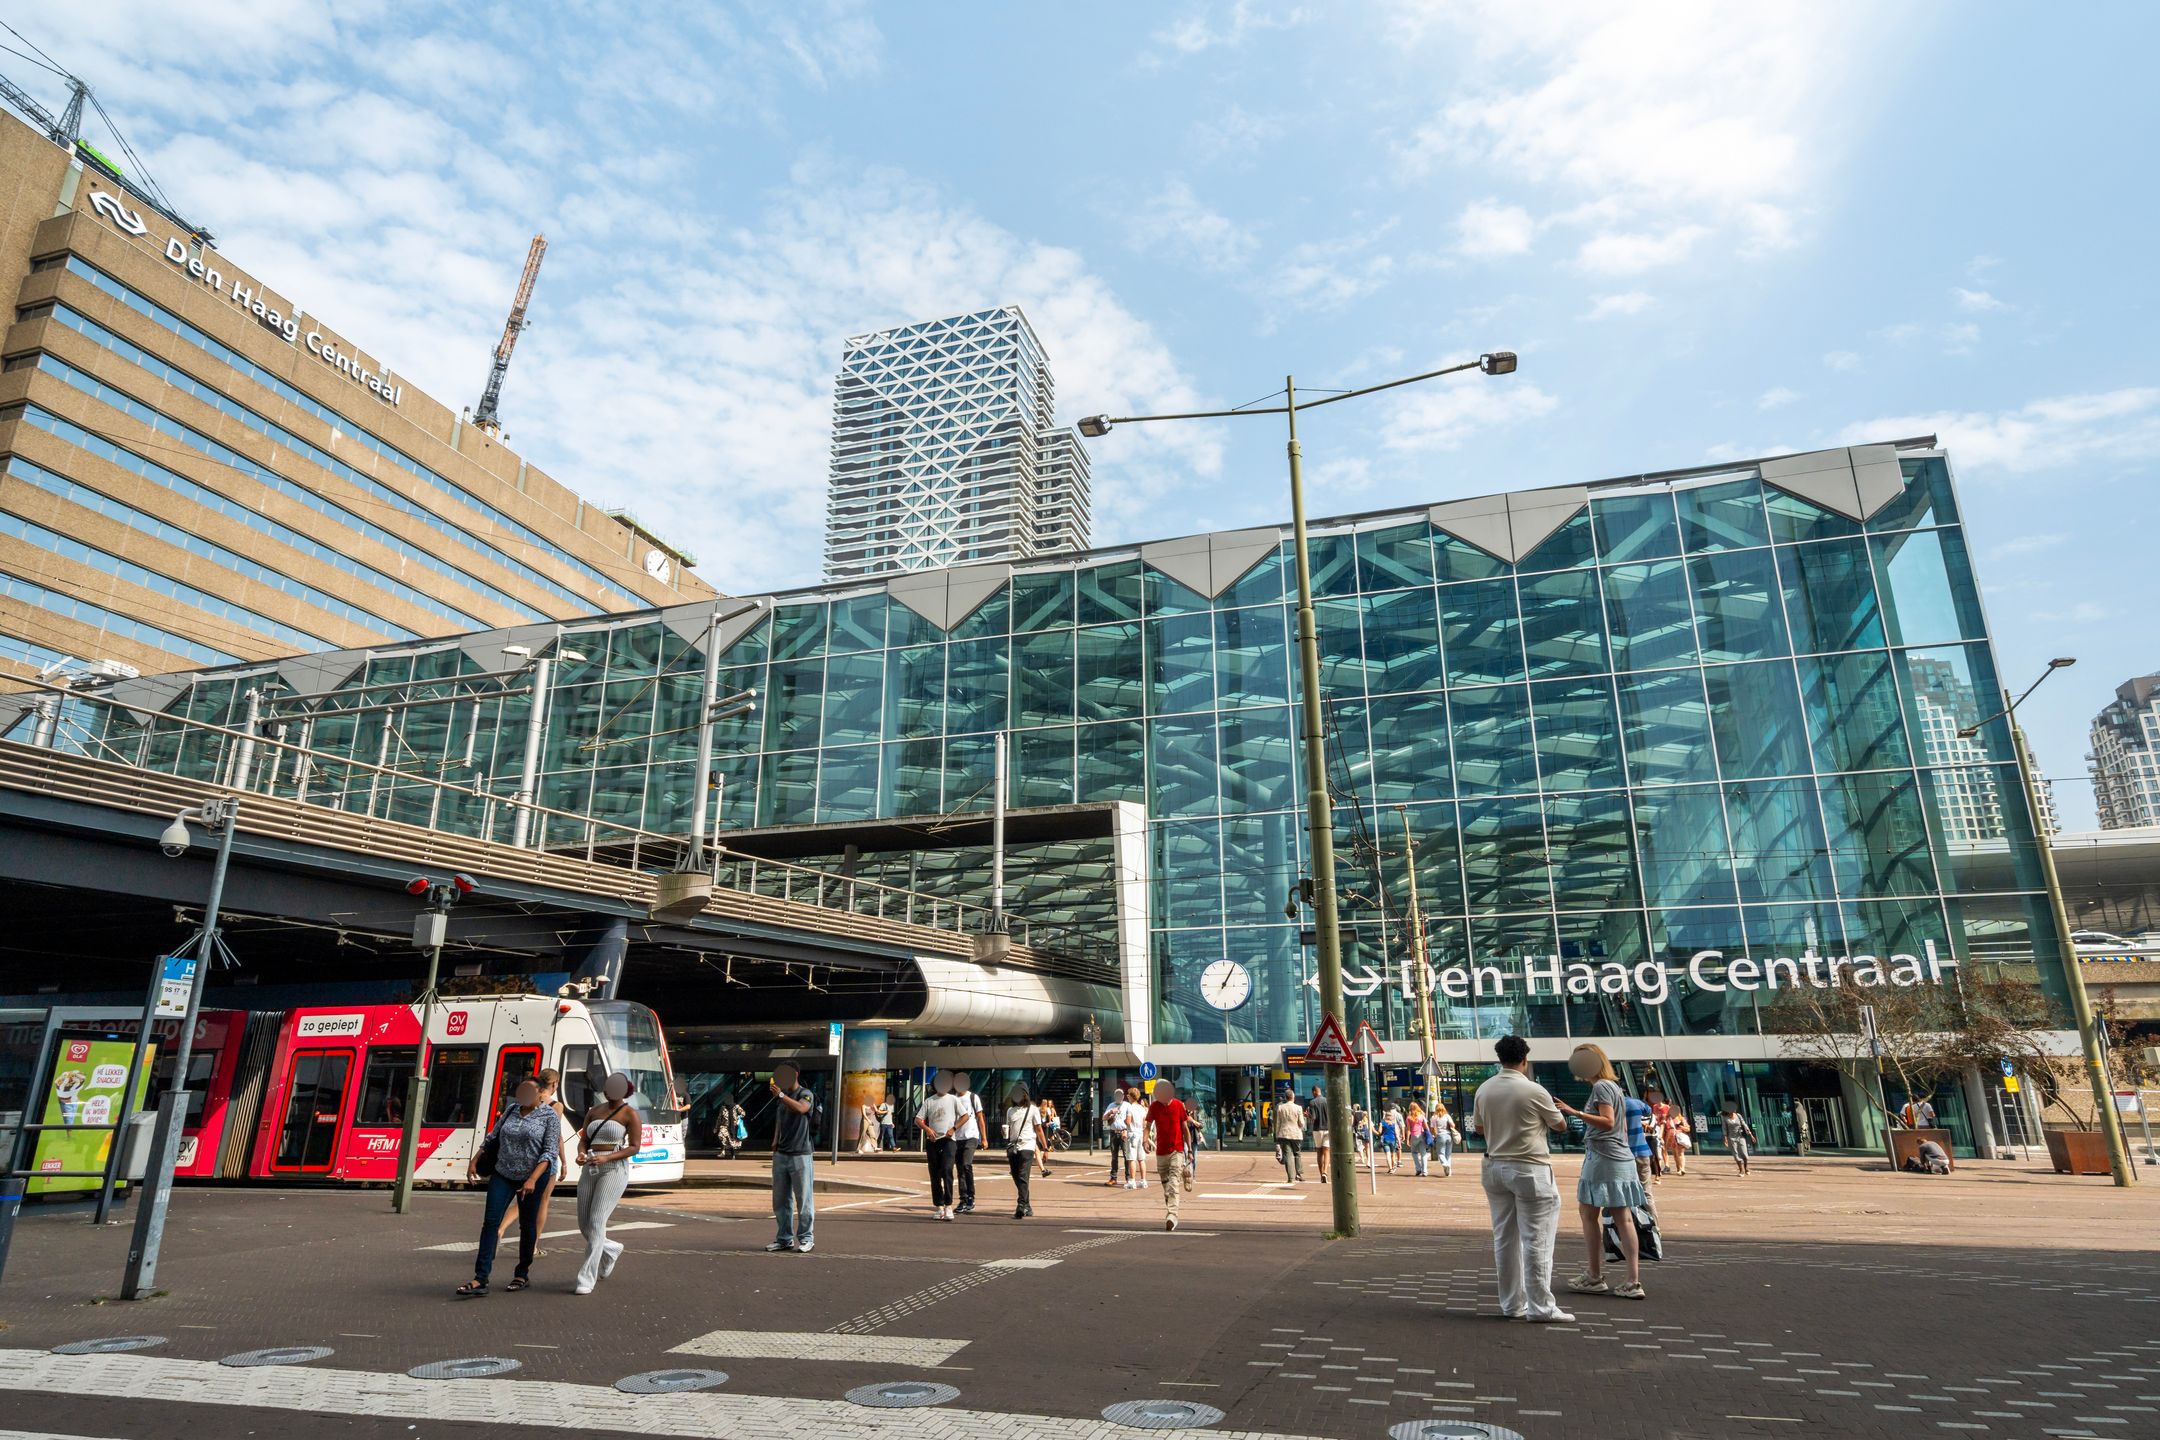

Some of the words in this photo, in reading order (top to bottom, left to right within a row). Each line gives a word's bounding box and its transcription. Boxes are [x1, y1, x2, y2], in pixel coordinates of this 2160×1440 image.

[165, 237, 222, 289] Den
[231, 280, 298, 341] Haag
[305, 332, 401, 405] Centraal
[1400, 960, 1504, 999] Den
[1524, 955, 1669, 1005] Haag
[1689, 939, 1944, 992] Centraal
[303, 1022, 315, 1031] zo
[317, 1019, 359, 1033] gepiept
[450, 1014, 466, 1025] OV
[178, 1141, 196, 1153] OV
[367, 1138, 396, 1150] HTM
